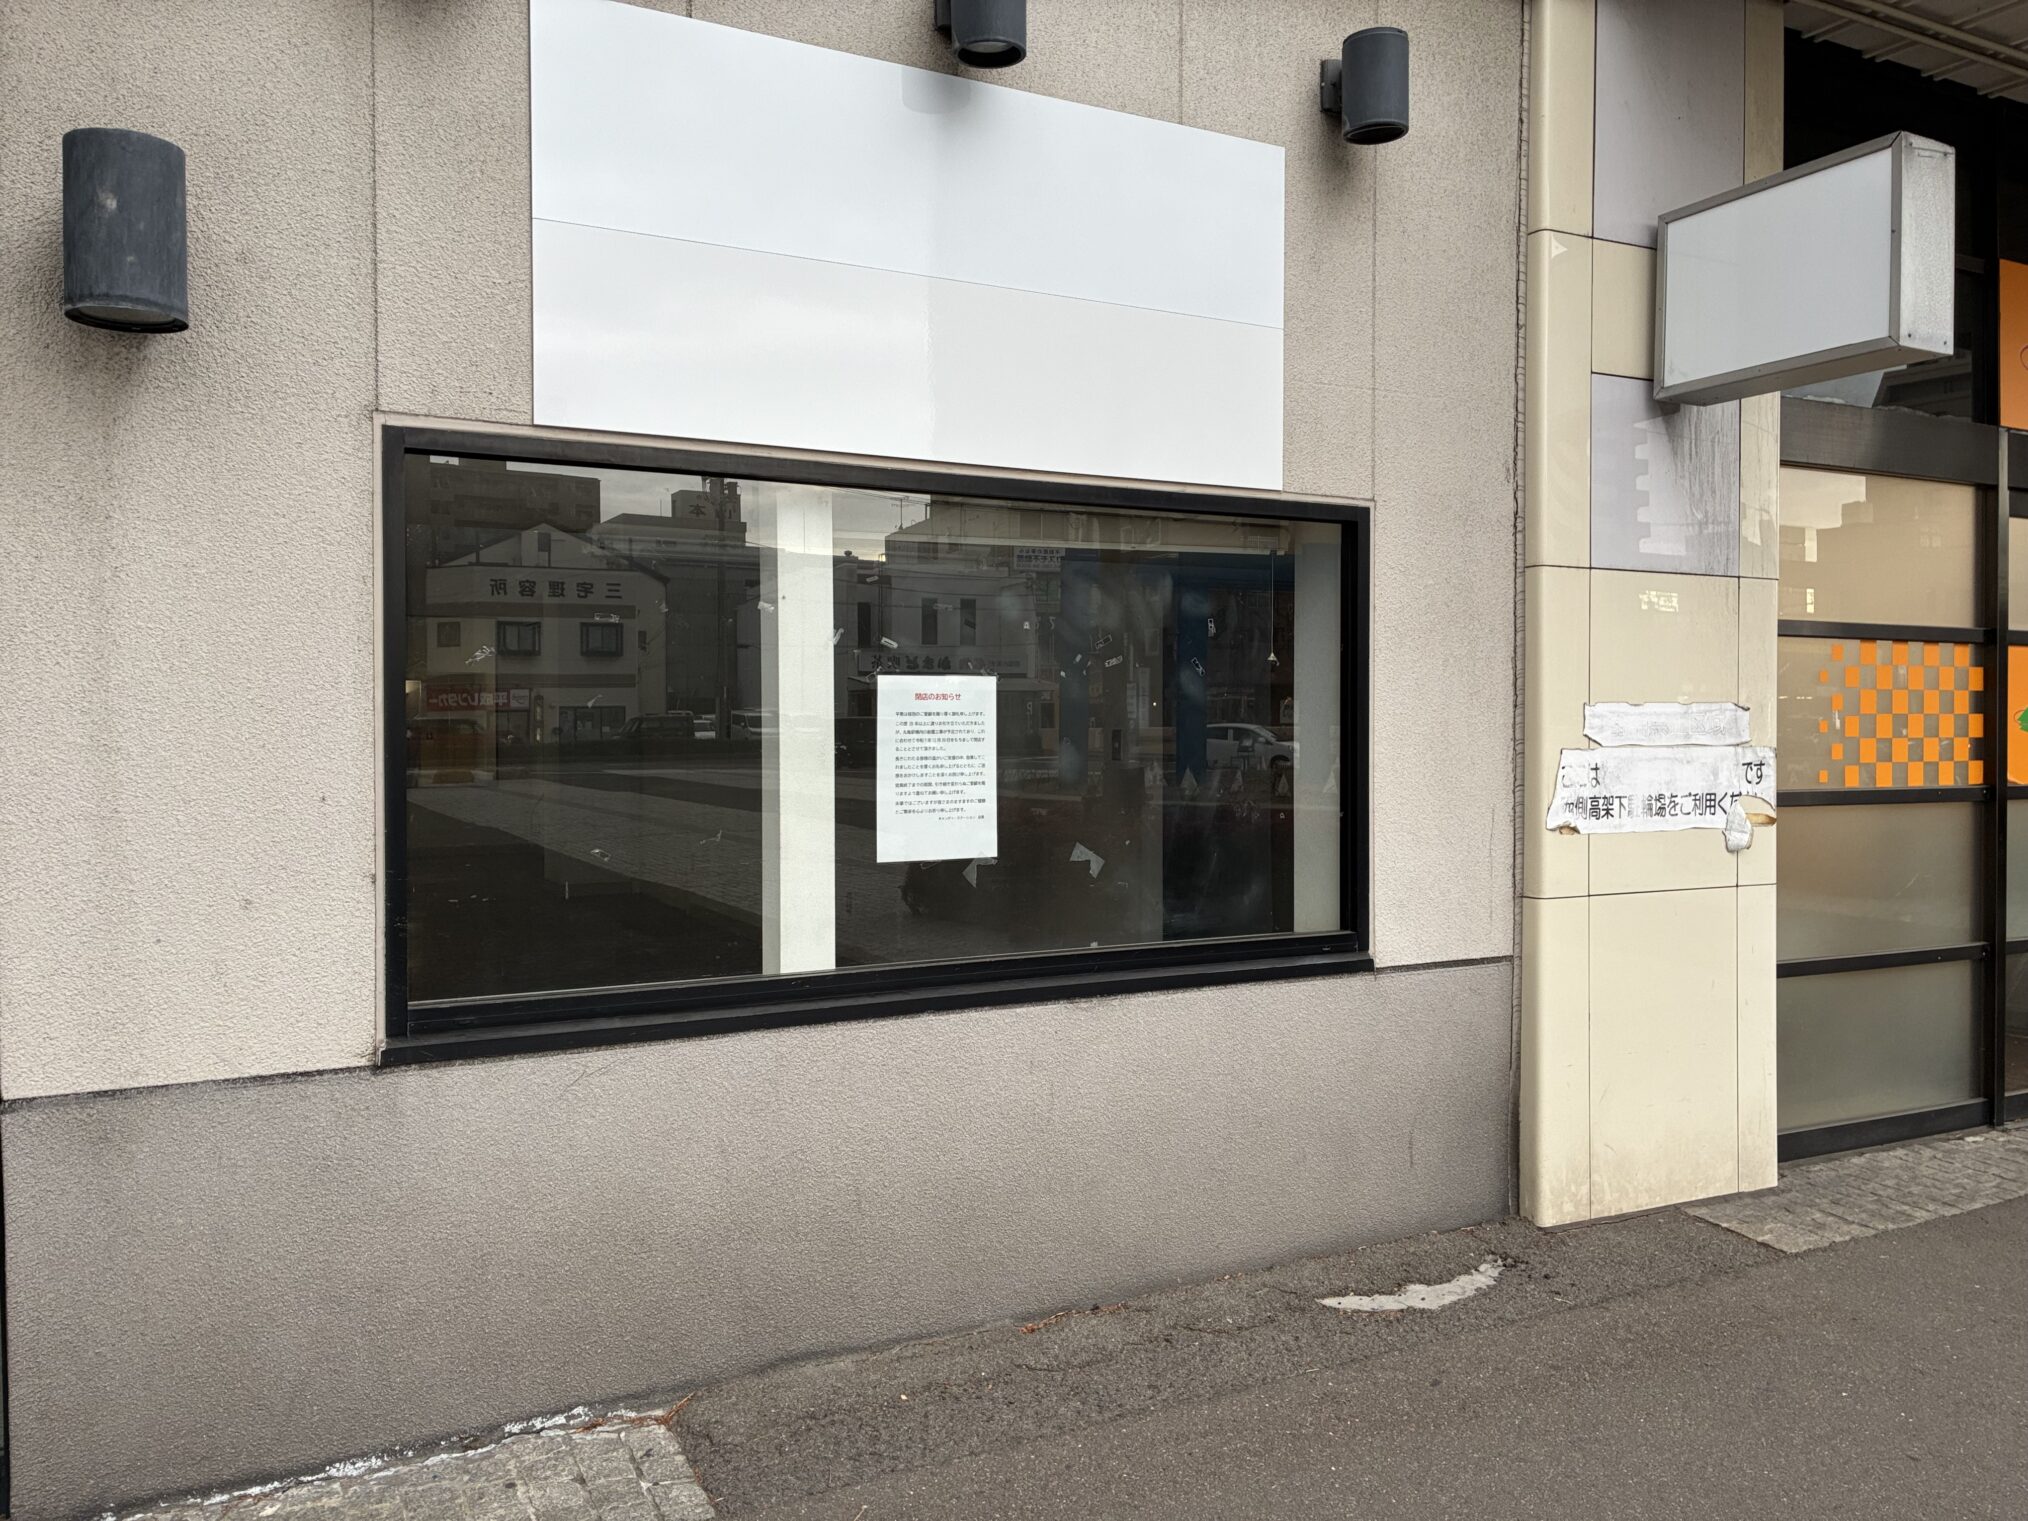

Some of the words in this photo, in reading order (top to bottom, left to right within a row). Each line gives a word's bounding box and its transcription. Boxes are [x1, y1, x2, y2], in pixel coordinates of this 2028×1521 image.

[914, 692, 962, 701] 閉店のお知らせ
[1741, 760, 1766, 786] です
